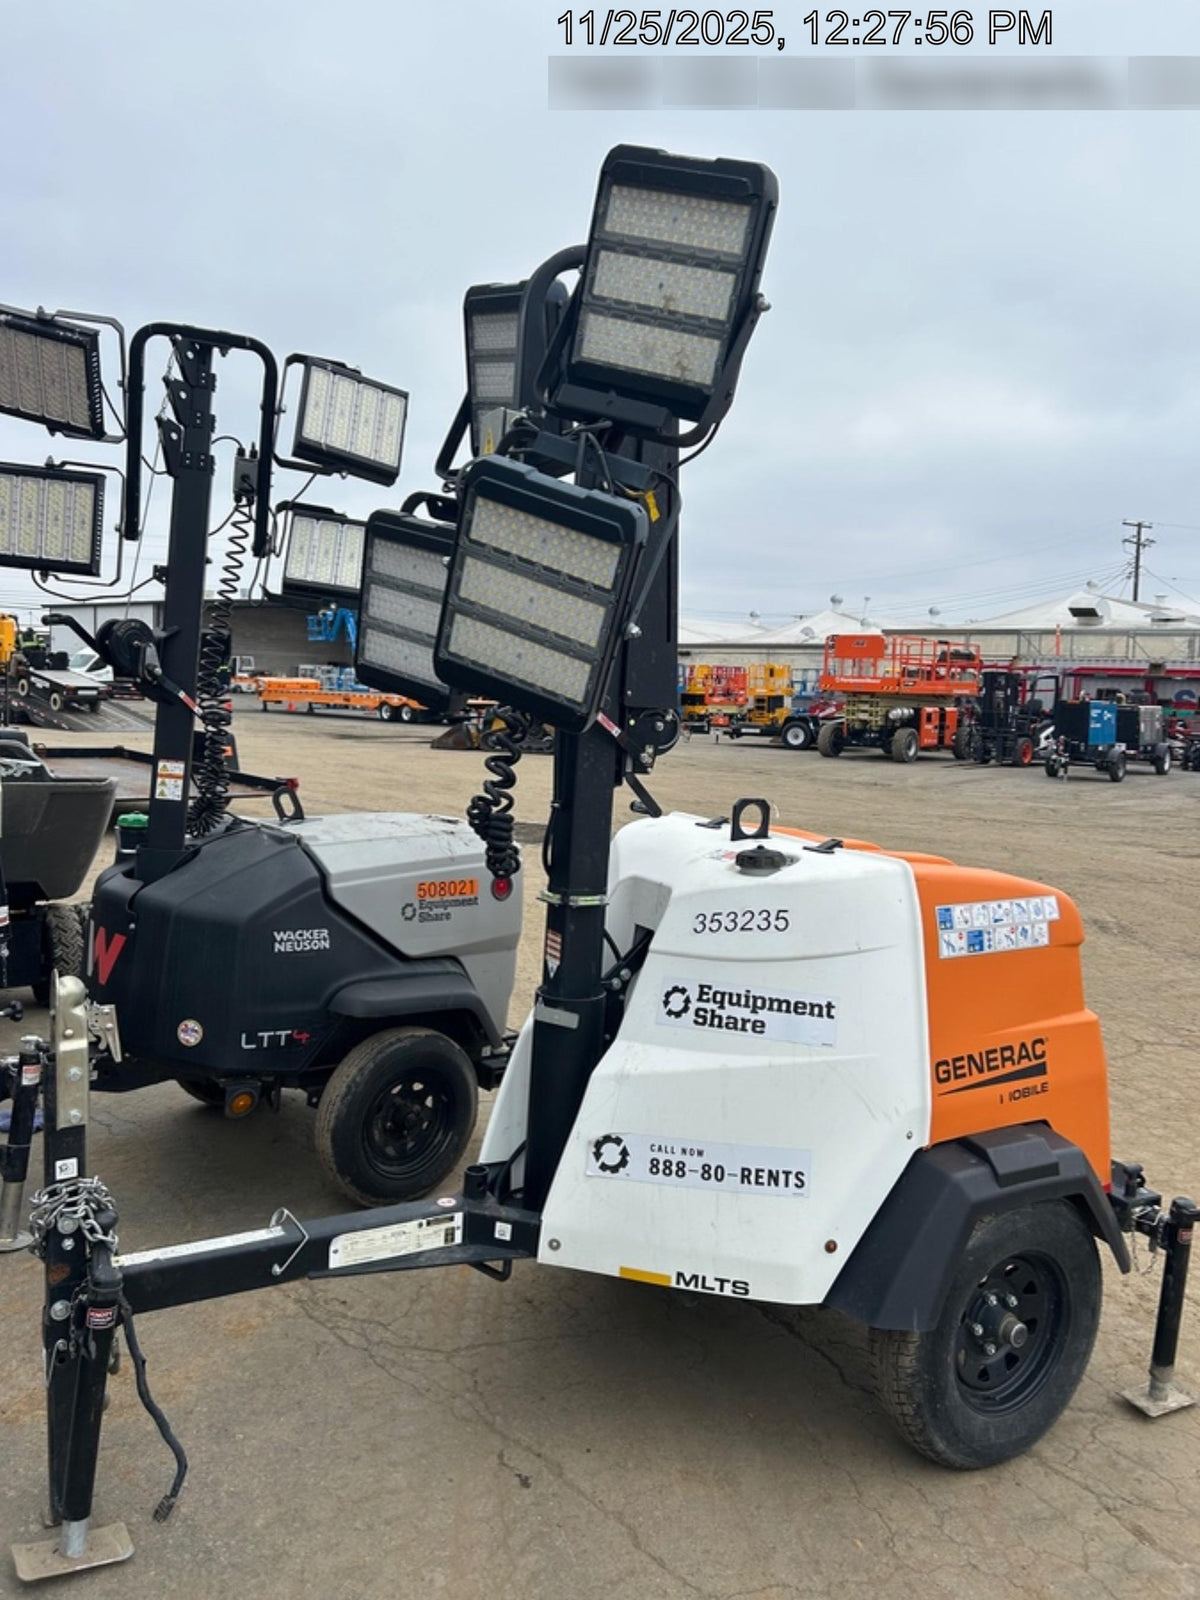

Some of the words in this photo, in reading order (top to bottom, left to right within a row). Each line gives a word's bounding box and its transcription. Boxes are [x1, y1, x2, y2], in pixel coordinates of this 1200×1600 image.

[417, 880, 475, 898] 508021
[418, 911, 452, 923] Share
[693, 909, 790, 934] 353235
[273, 929, 329, 941] WACKER
[274, 940, 330, 953] NEUSON
[696, 984, 836, 1019] Equipment
[693, 1007, 766, 1034] Share
[935, 1037, 1047, 1084] GENERAC
[650, 1144, 675, 1155] CALL
[681, 1147, 705, 1158] NOW
[649, 1157, 806, 1189] 888-80-RENTS
[675, 1271, 750, 1296] MLTS
